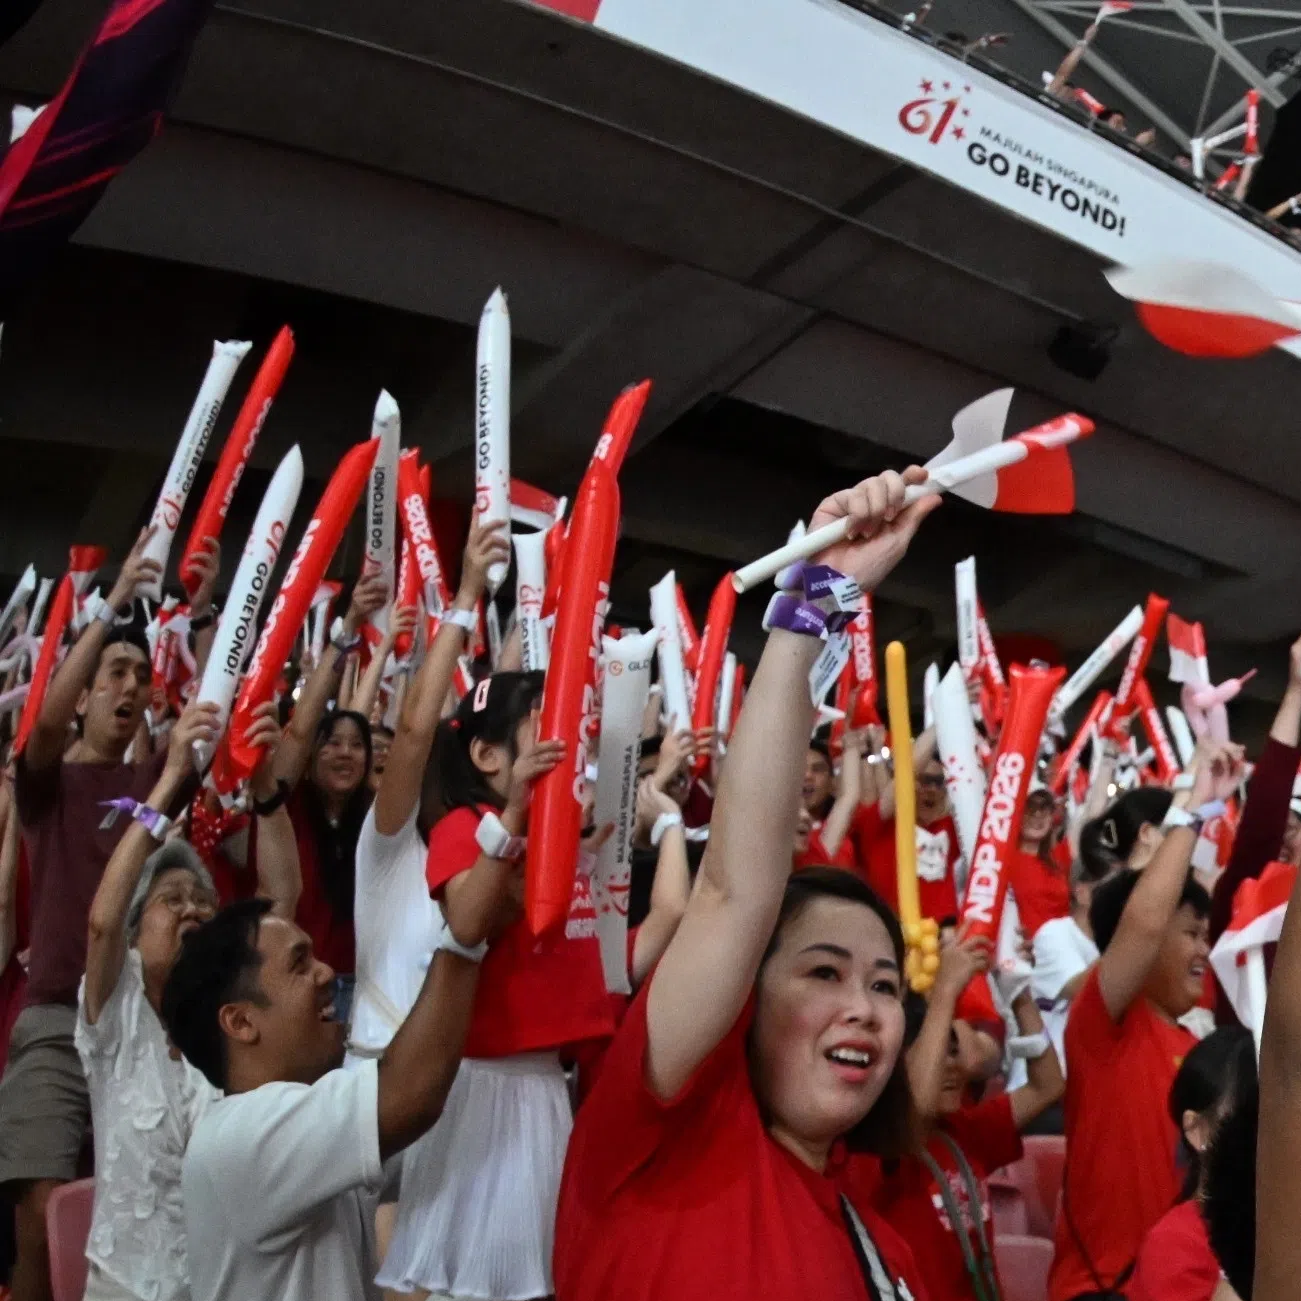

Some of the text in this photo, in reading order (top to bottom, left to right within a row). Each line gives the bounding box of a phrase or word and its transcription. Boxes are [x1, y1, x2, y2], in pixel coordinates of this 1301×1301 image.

[967, 142, 1127, 237] GO BEYOND!
[979, 126, 1120, 205] MAJULAH SINGAPURA
[479, 443, 491, 469] GO
[370, 466, 385, 549] GO BEYOND!
[224, 561, 268, 677] GO BEYOND!
[964, 751, 1027, 923] NDP 2026
